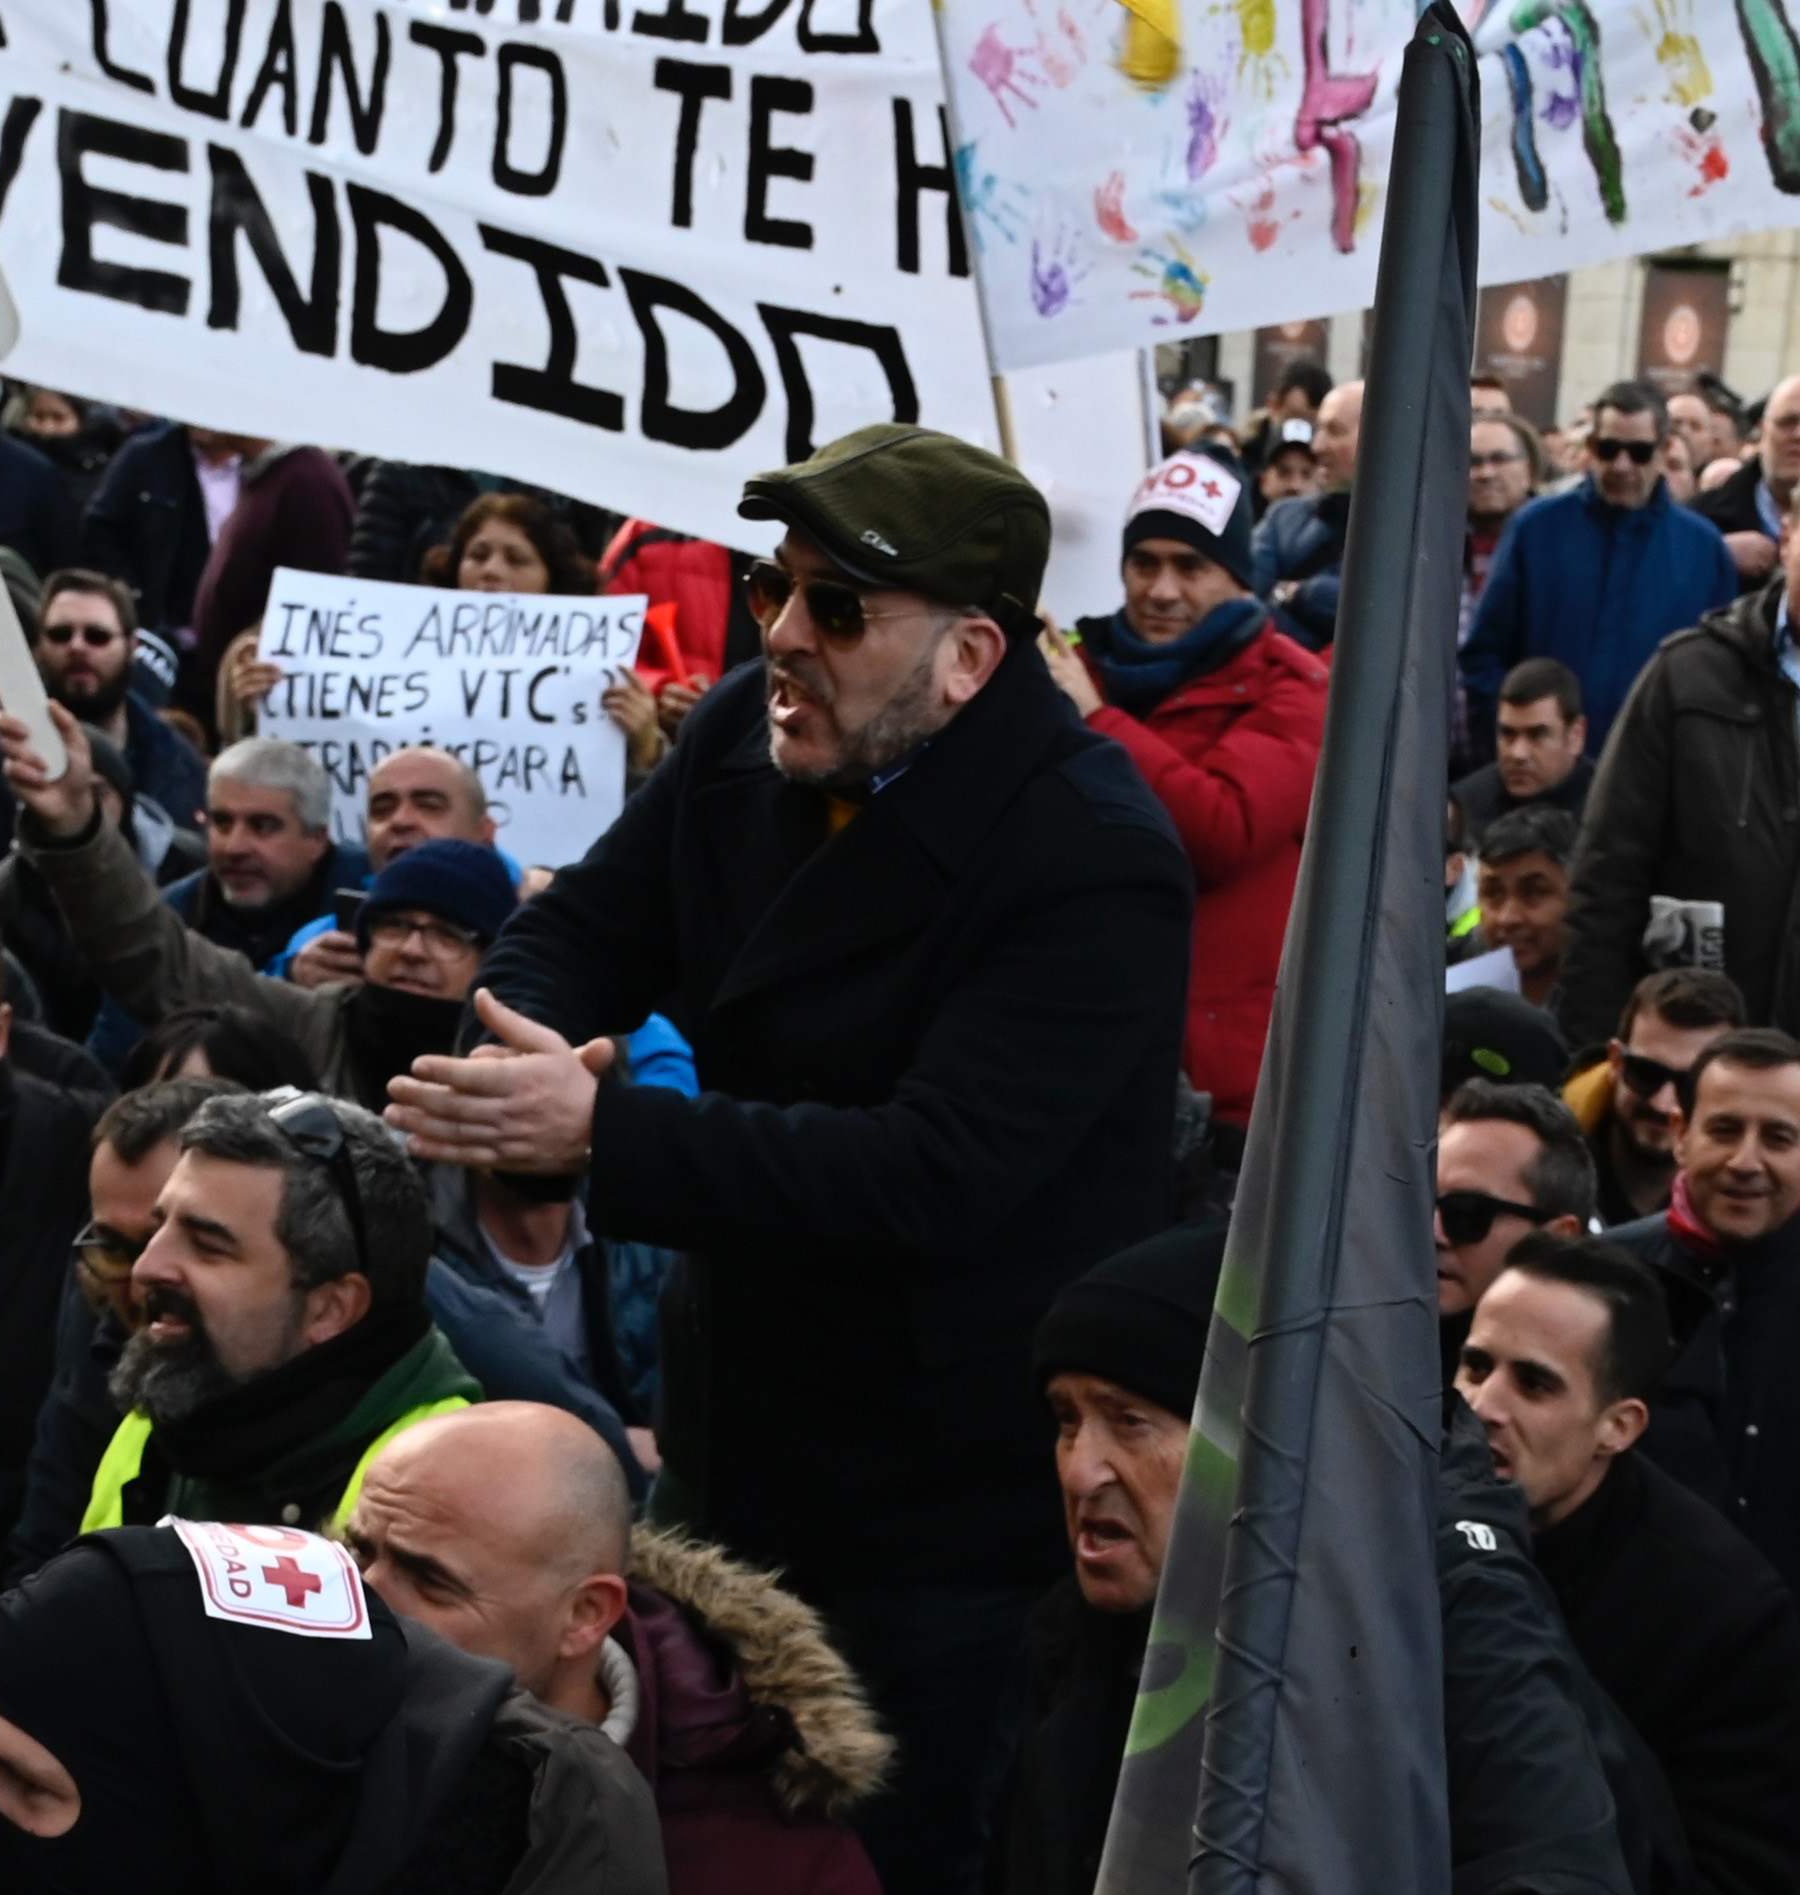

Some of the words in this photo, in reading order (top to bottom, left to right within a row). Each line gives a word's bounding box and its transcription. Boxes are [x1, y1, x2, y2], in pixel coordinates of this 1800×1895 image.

[654, 57, 815, 250] TE
[269, 598, 384, 660] INÉS
[403, 598, 640, 661] ARRIMADAS
